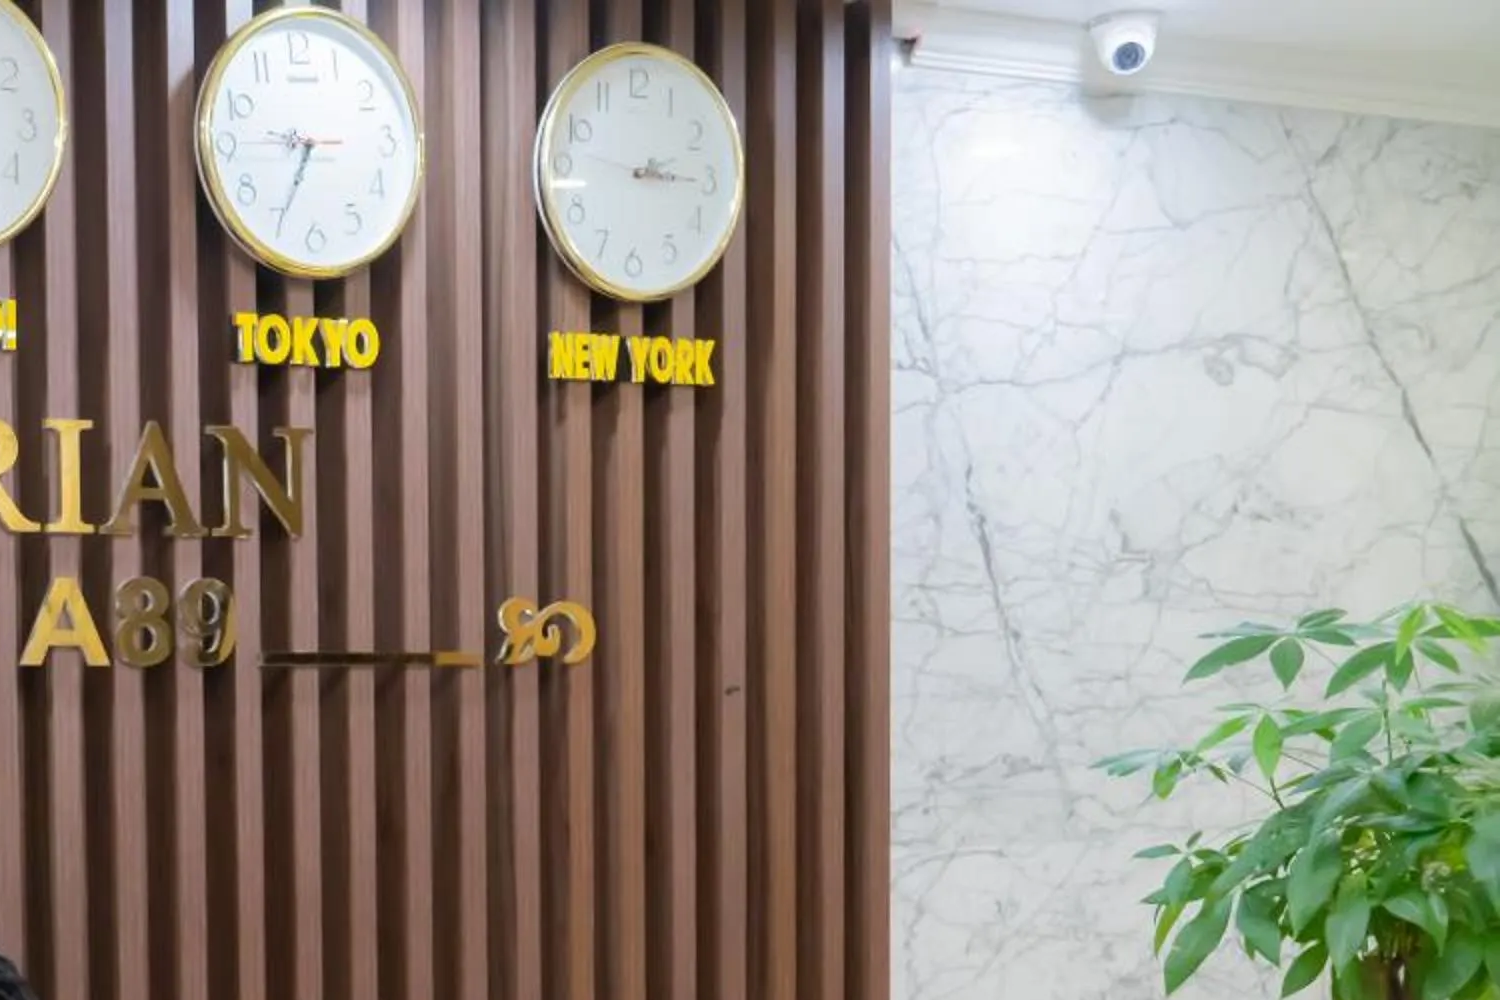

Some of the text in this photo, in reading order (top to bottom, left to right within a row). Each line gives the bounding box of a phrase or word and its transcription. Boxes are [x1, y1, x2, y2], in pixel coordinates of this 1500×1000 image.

[287, 31, 311, 65] 12
[1, 57, 19, 93] 2
[252, 50, 271, 84] 11
[629, 67, 649, 99] 12
[227, 88, 254, 121] 10
[357, 78, 376, 111] 2
[597, 81, 610, 113] 11
[18, 108, 37, 143] 3
[379, 125, 397, 158] 3
[568, 113, 593, 145] 10
[688, 119, 703, 151] 2
[215, 131, 237, 163] 9
[3, 151, 19, 185] 4
[369, 167, 385, 199] 4
[701, 164, 717, 196] 3
[236, 172, 257, 207] 8
[269, 207, 287, 239] 7
[345, 203, 363, 236] 5
[567, 193, 585, 225] 8
[304, 222, 327, 253] 6
[596, 229, 609, 260] 7
[660, 233, 677, 265] 5
[624, 246, 643, 279] 6
[234, 311, 380, 369] TOKYO
[549, 331, 715, 385] NEW YORK
[19, 576, 238, 670] A89
